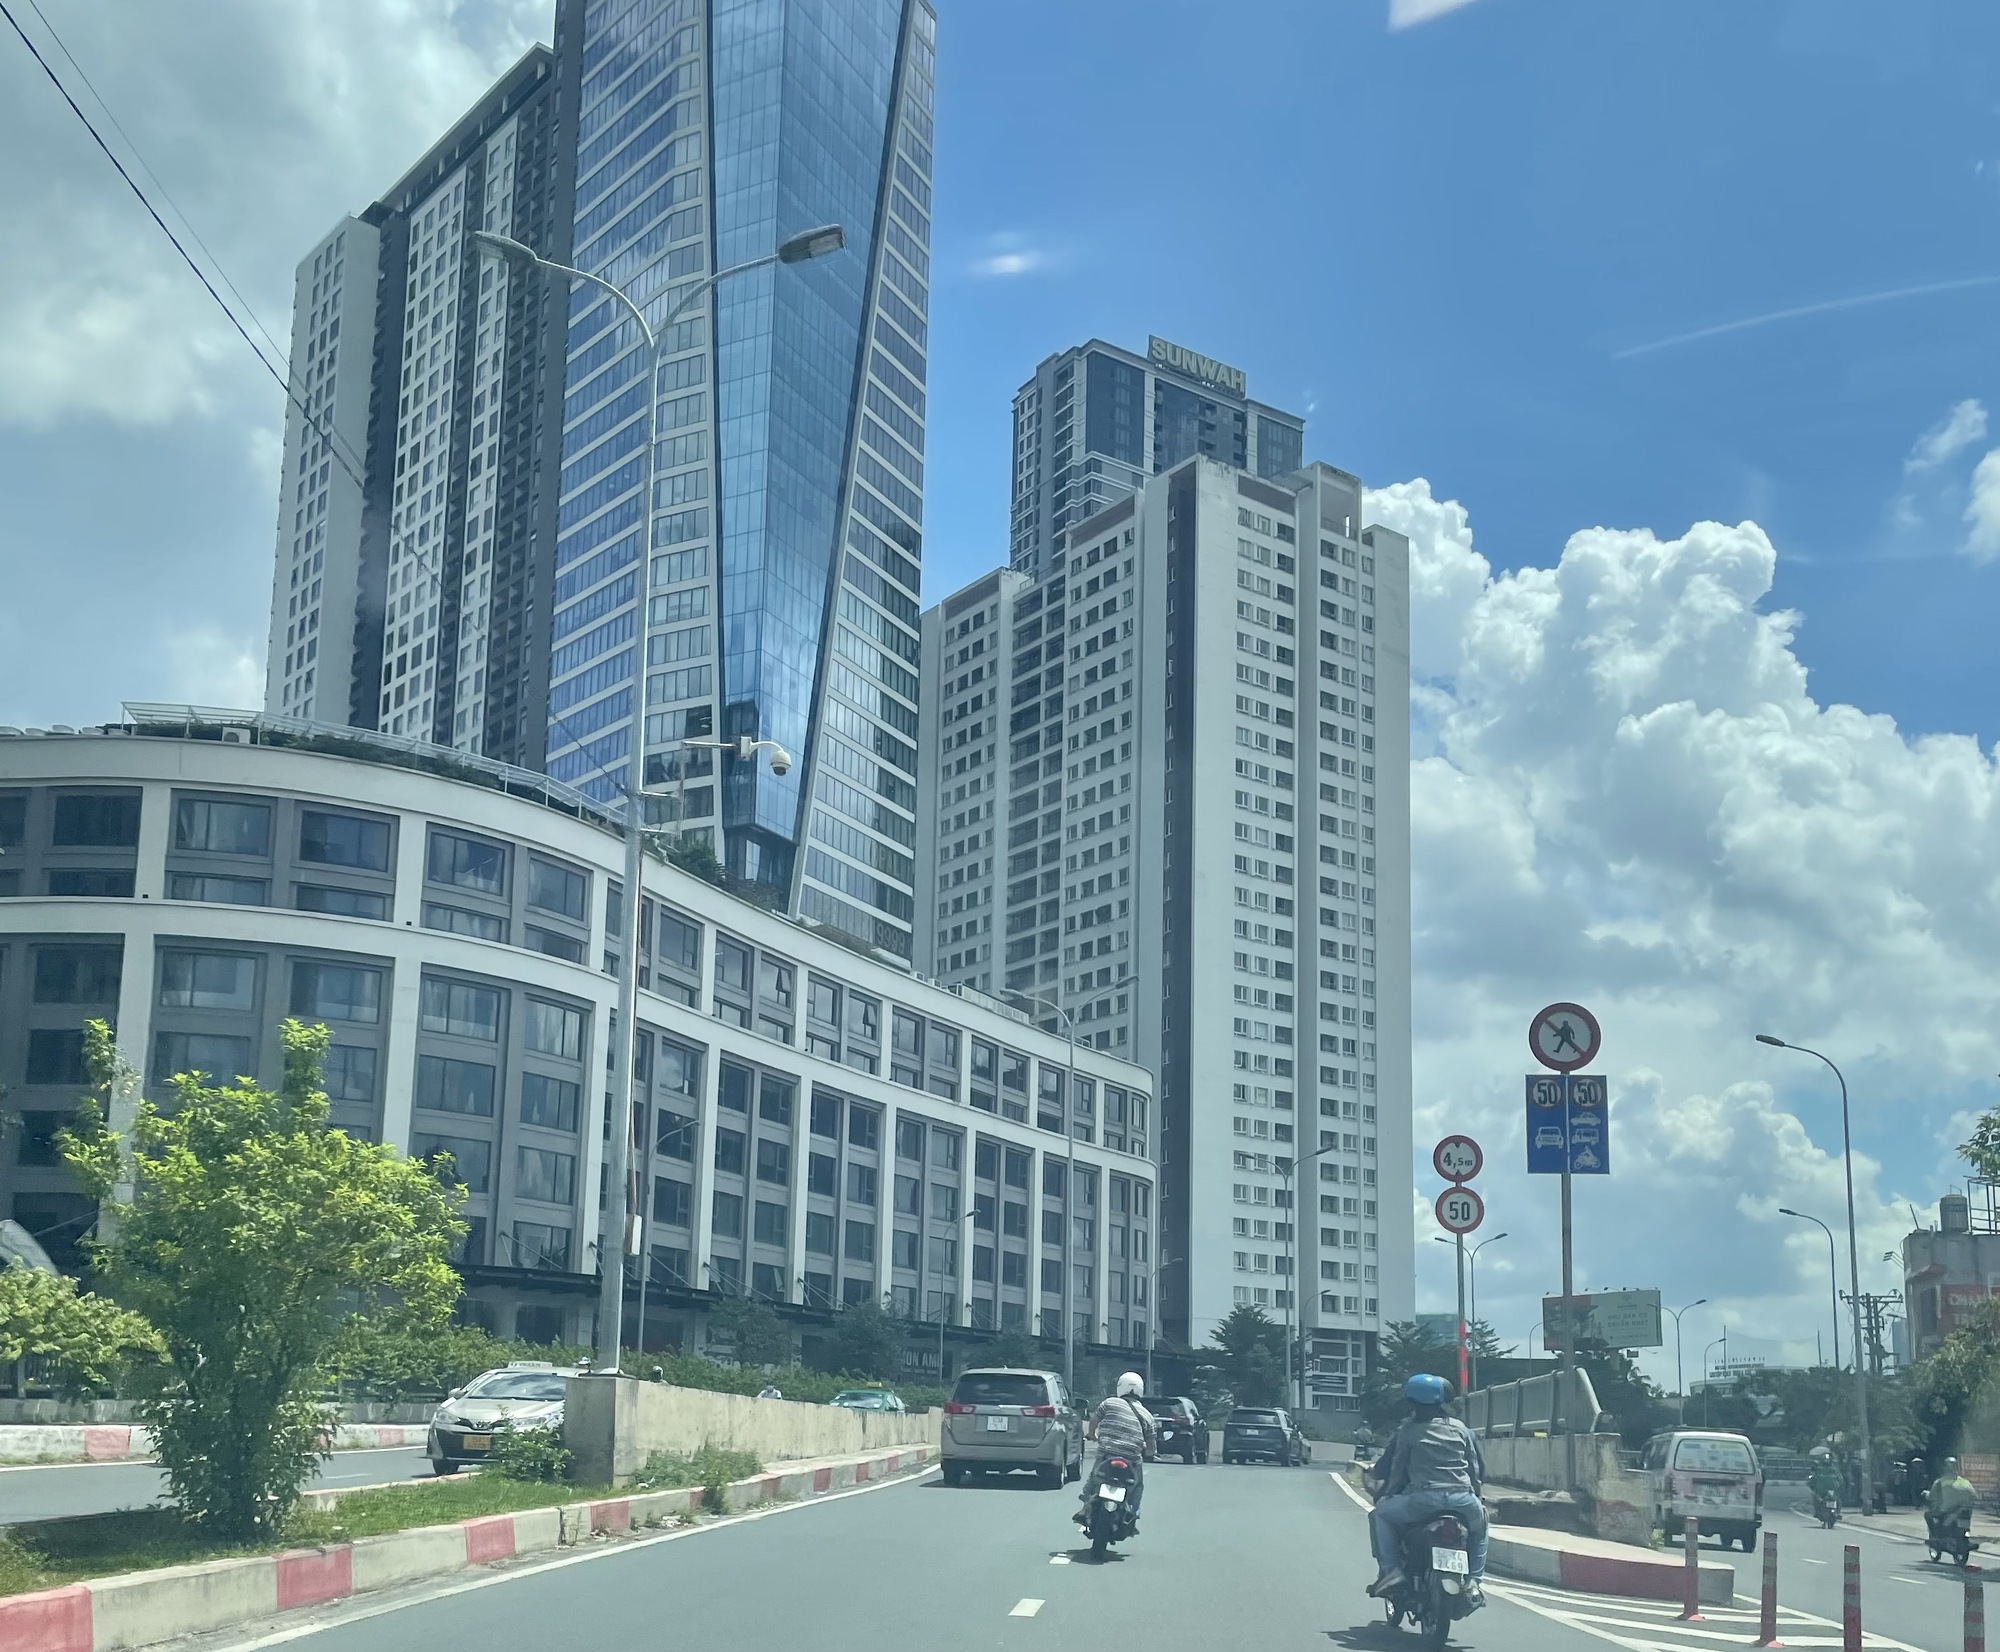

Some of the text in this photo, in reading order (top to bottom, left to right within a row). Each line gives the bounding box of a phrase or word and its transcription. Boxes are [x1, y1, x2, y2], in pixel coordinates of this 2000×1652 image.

[1151, 338, 1246, 393] SUNWAH
[1537, 1082, 1558, 1105] 50
[1577, 1082, 1599, 1105] 50
[1449, 1201, 1471, 1221] 50
